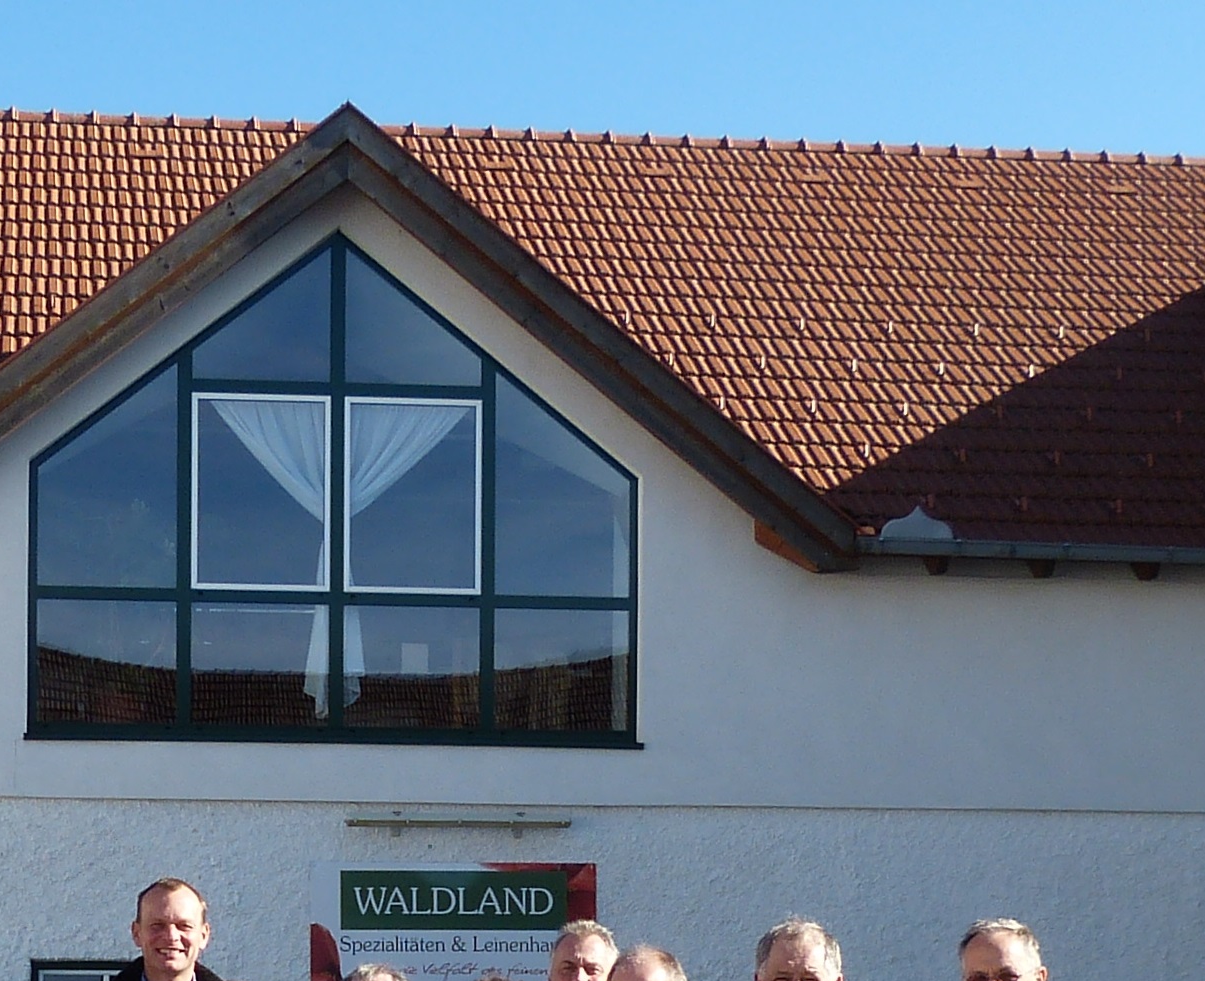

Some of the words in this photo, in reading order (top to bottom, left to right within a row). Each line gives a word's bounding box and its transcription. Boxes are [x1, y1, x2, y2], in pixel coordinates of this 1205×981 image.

[354, 887, 554, 915] WALDLAND
[340, 935, 445, 955] Spezialitäten
[451, 936, 466, 952] &
